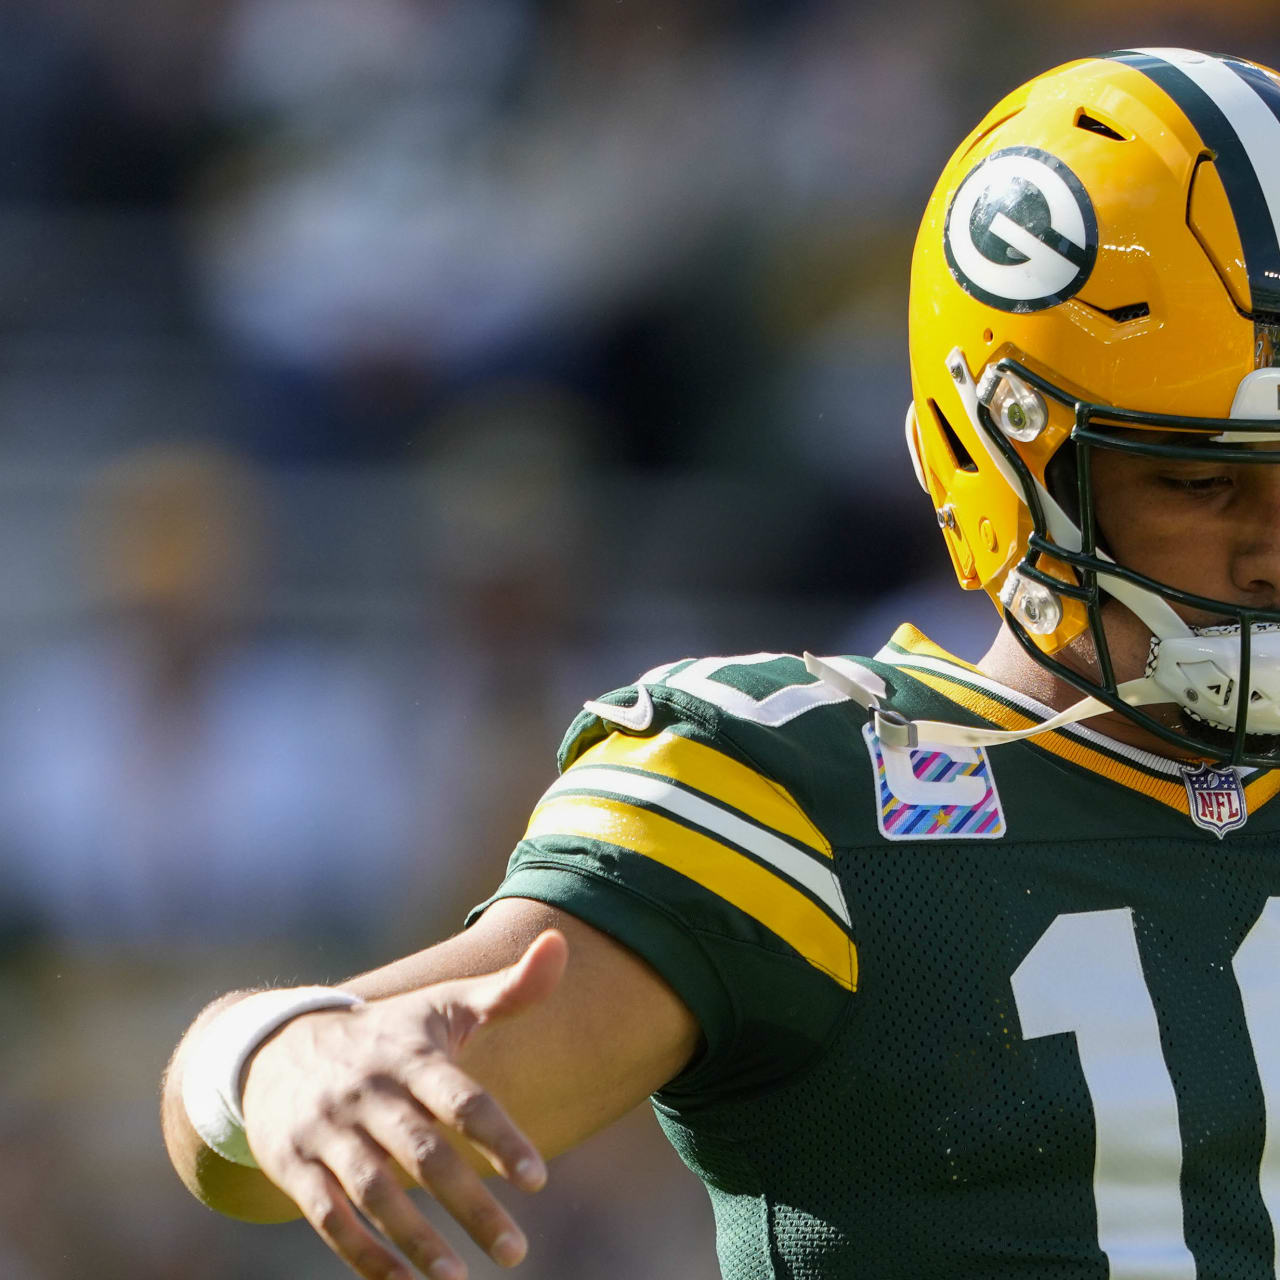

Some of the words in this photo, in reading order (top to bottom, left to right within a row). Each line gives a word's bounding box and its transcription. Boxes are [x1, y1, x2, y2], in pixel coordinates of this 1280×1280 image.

[946, 150, 1090, 303] G
[879, 734, 987, 807] C
[1198, 791, 1239, 823] NFL
